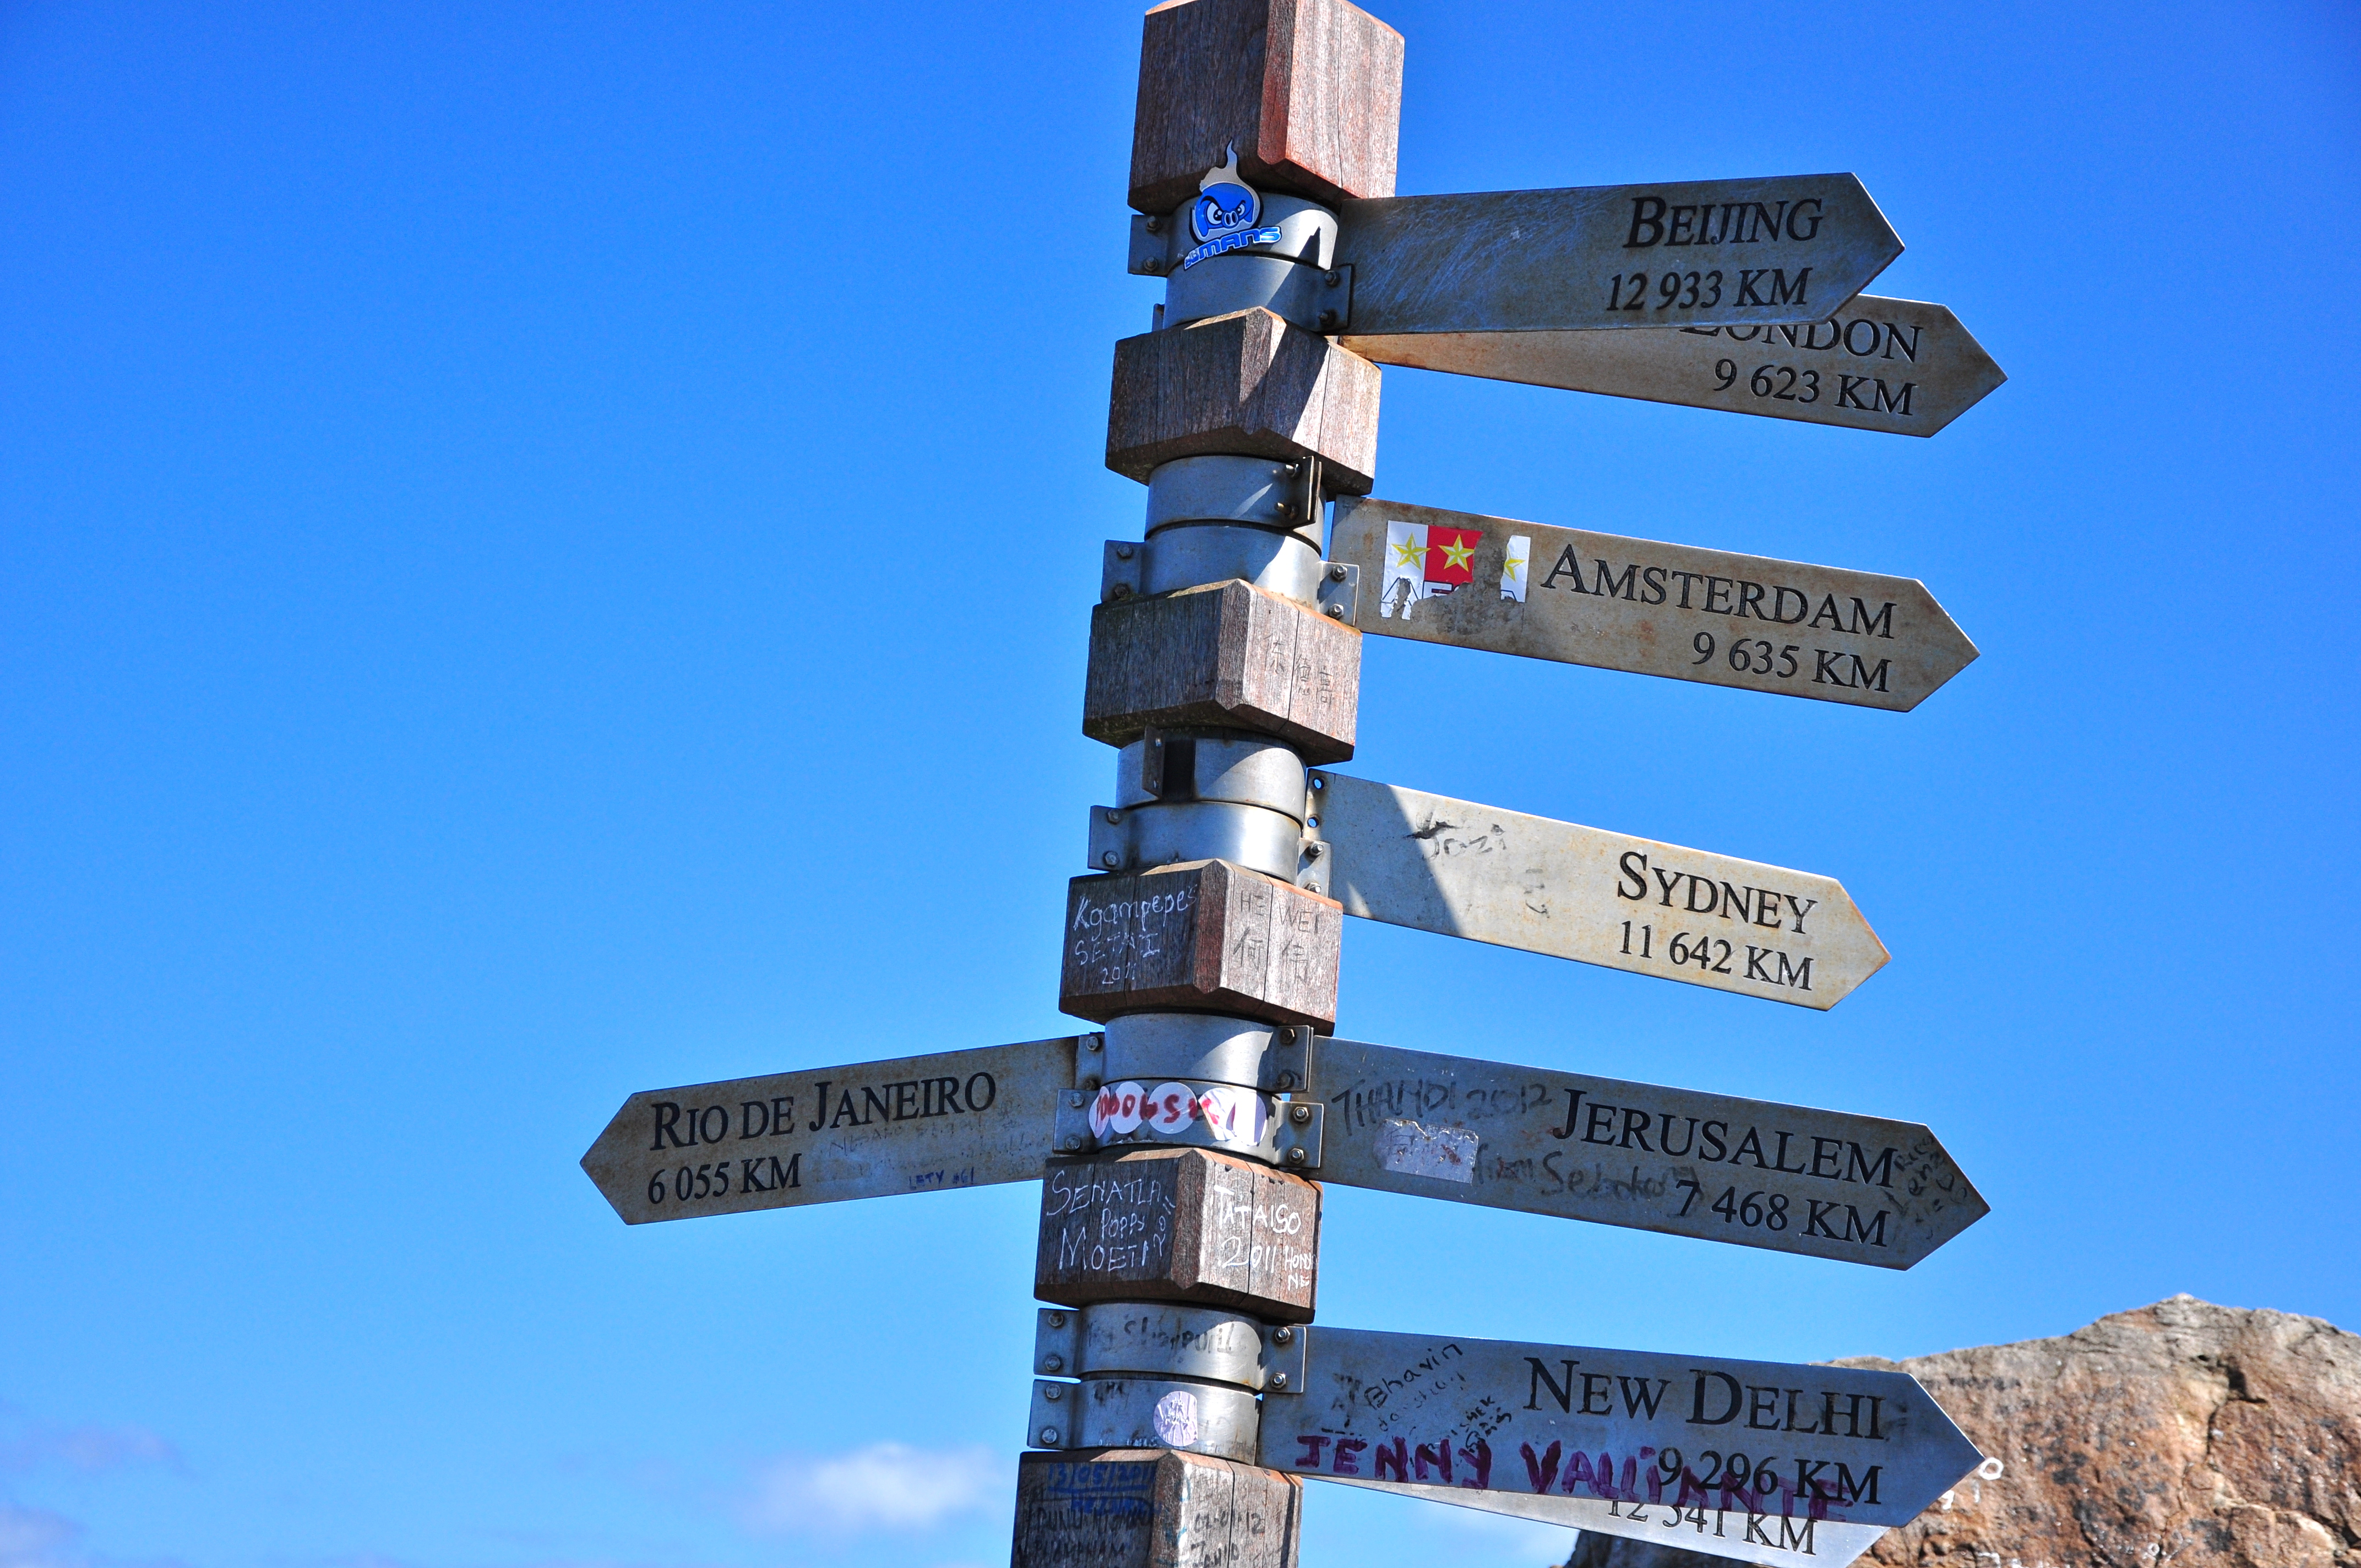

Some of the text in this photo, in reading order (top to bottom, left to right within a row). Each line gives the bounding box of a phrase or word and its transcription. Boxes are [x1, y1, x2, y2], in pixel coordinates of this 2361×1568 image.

[1623, 196, 1823, 248] BEIJING
[1607, 268, 1813, 313] 12 933 KM
[1679, 318, 1924, 363] NDON
[1713, 358, 1917, 416] 9 623 KM
[1541, 544, 1897, 639] AMSTERDAM
[1693, 631, 1892, 693] 9 635 KM
[1618, 851, 1818, 934] SYDNEY
[1619, 921, 1814, 991] 11 642 KM
[649, 1102, 728, 1151] RIO
[739, 1097, 795, 1139] DE
[809, 1072, 996, 1132] JANEIRO
[1552, 1088, 1898, 1188] JERUSALEM
[648, 1153, 802, 1204] 6 055 KM
[1674, 1179, 1701, 1217] 7
[1711, 1186, 1789, 1231] 468
[1802, 1199, 1891, 1247] KM
[1523, 1357, 1671, 1421] NEW
[1686, 1369, 1887, 1441] DELHI
[1295, 1435, 1492, 1490] JENNY
[1658, 1447, 1883, 1505] 9 296 KM
[1742, 1512, 1818, 1555] KM
